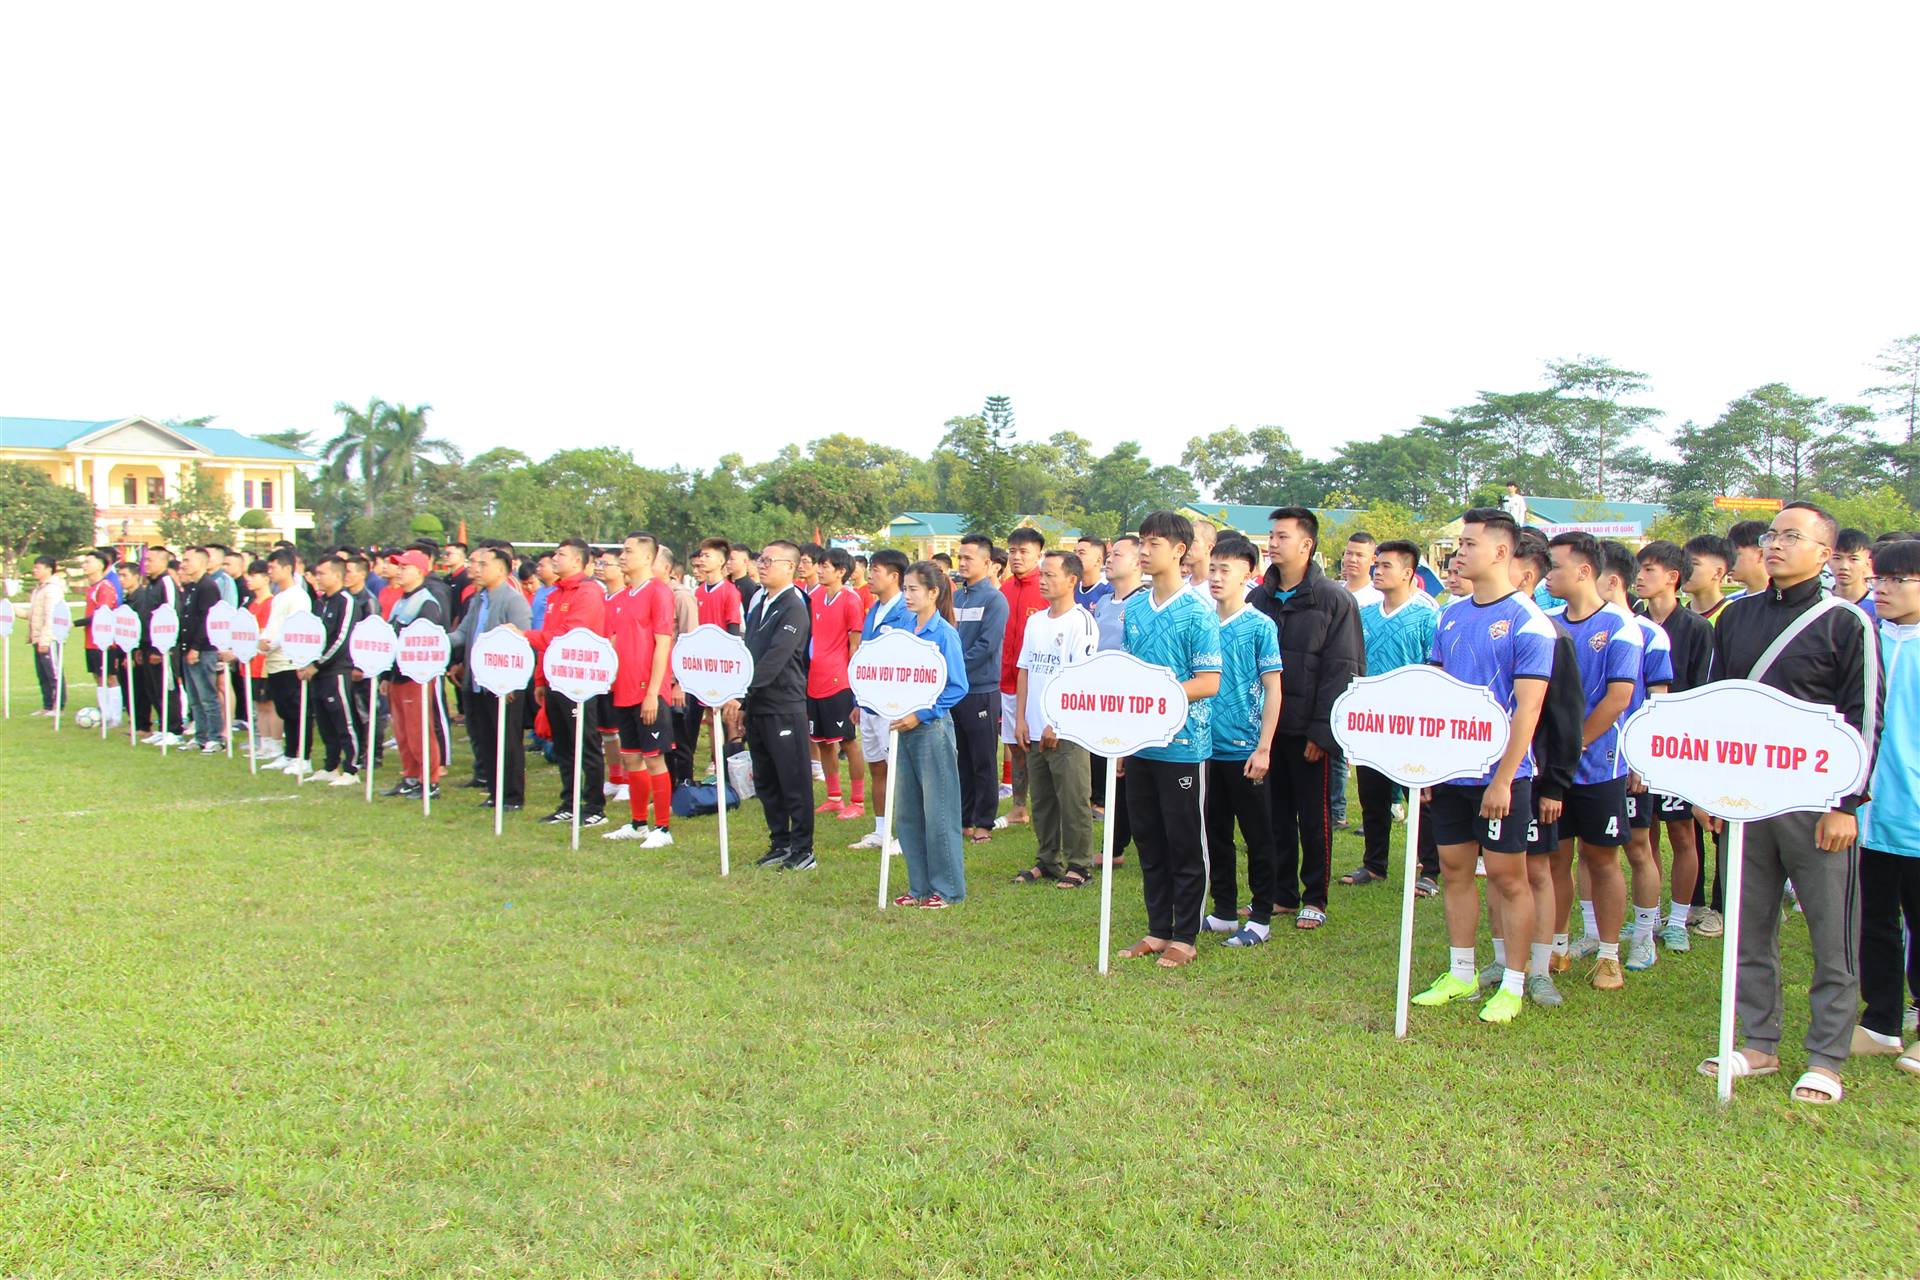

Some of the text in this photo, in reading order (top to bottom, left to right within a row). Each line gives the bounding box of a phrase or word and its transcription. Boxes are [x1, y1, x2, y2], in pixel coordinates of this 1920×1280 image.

[484, 652, 524, 670] TRỌNG TÀI
[682, 655, 741, 675] ĐOÀN VĐV TDP 7
[856, 663, 878, 681] ĐOÀN
[879, 666, 894, 682] VĐV
[896, 667, 911, 683] TDP
[1061, 689, 1167, 715] ĐOÀN VĐV TDP 8
[1347, 708, 1492, 742] ĐOÀN VĐV TDP TRÁM
[1650, 732, 1829, 774] ĐOÀN VĐV TDP 2
[1661, 794, 1685, 812] 22
[1487, 817, 1502, 841] 9
[1526, 818, 1539, 842] 5
[1604, 815, 1619, 838] 4
